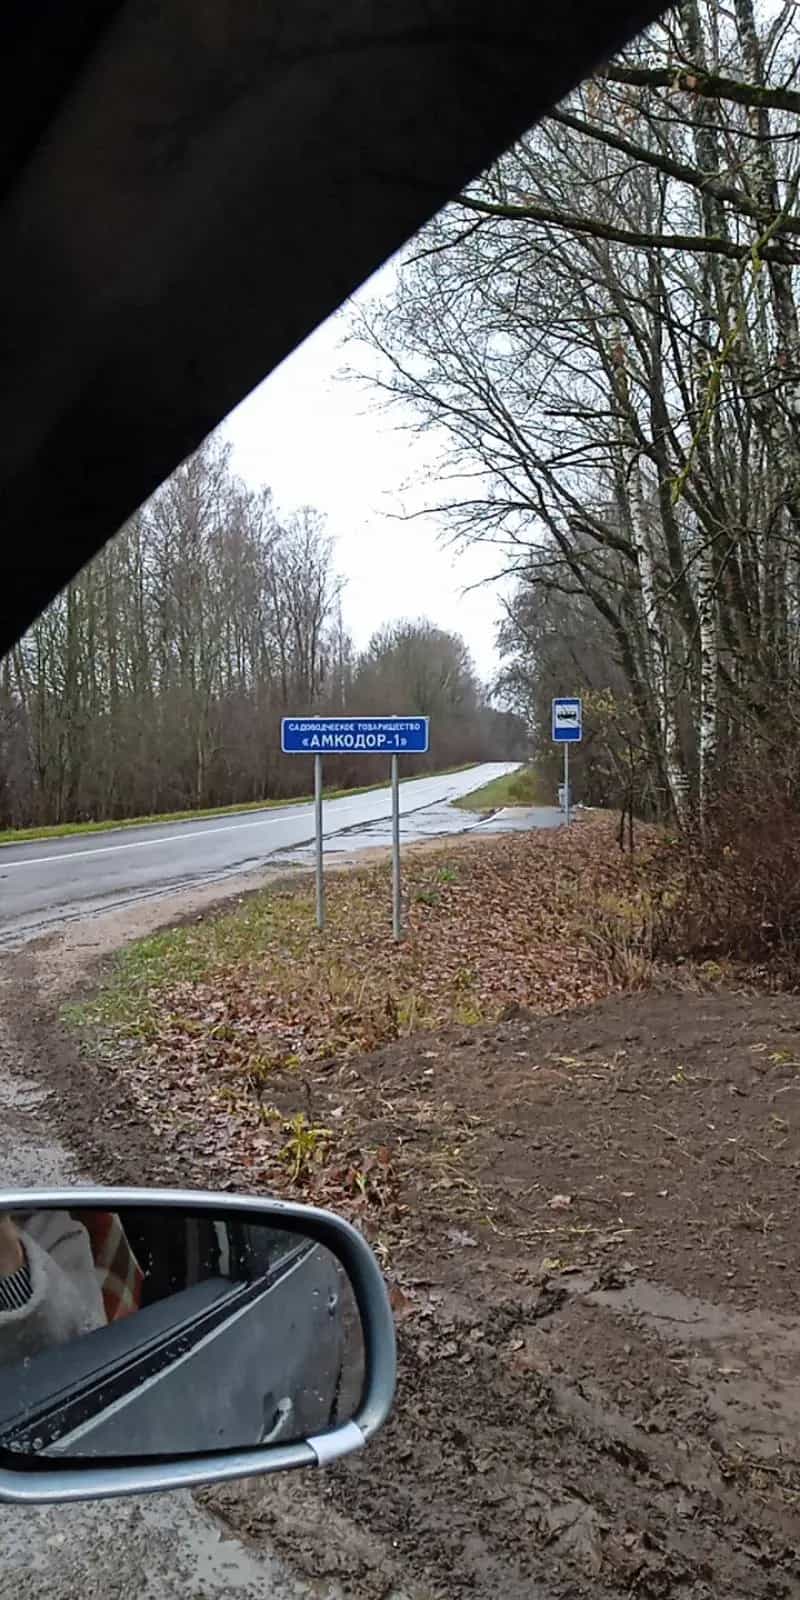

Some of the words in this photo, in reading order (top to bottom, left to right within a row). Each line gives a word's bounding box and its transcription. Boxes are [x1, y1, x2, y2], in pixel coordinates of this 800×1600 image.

[288, 723, 354, 731] САДОВОДЧЕСКОЕ
[358, 722, 420, 731] ТОВАРИЩЕСТВО
[302, 734, 407, 749] «АМКОДОР-1»
